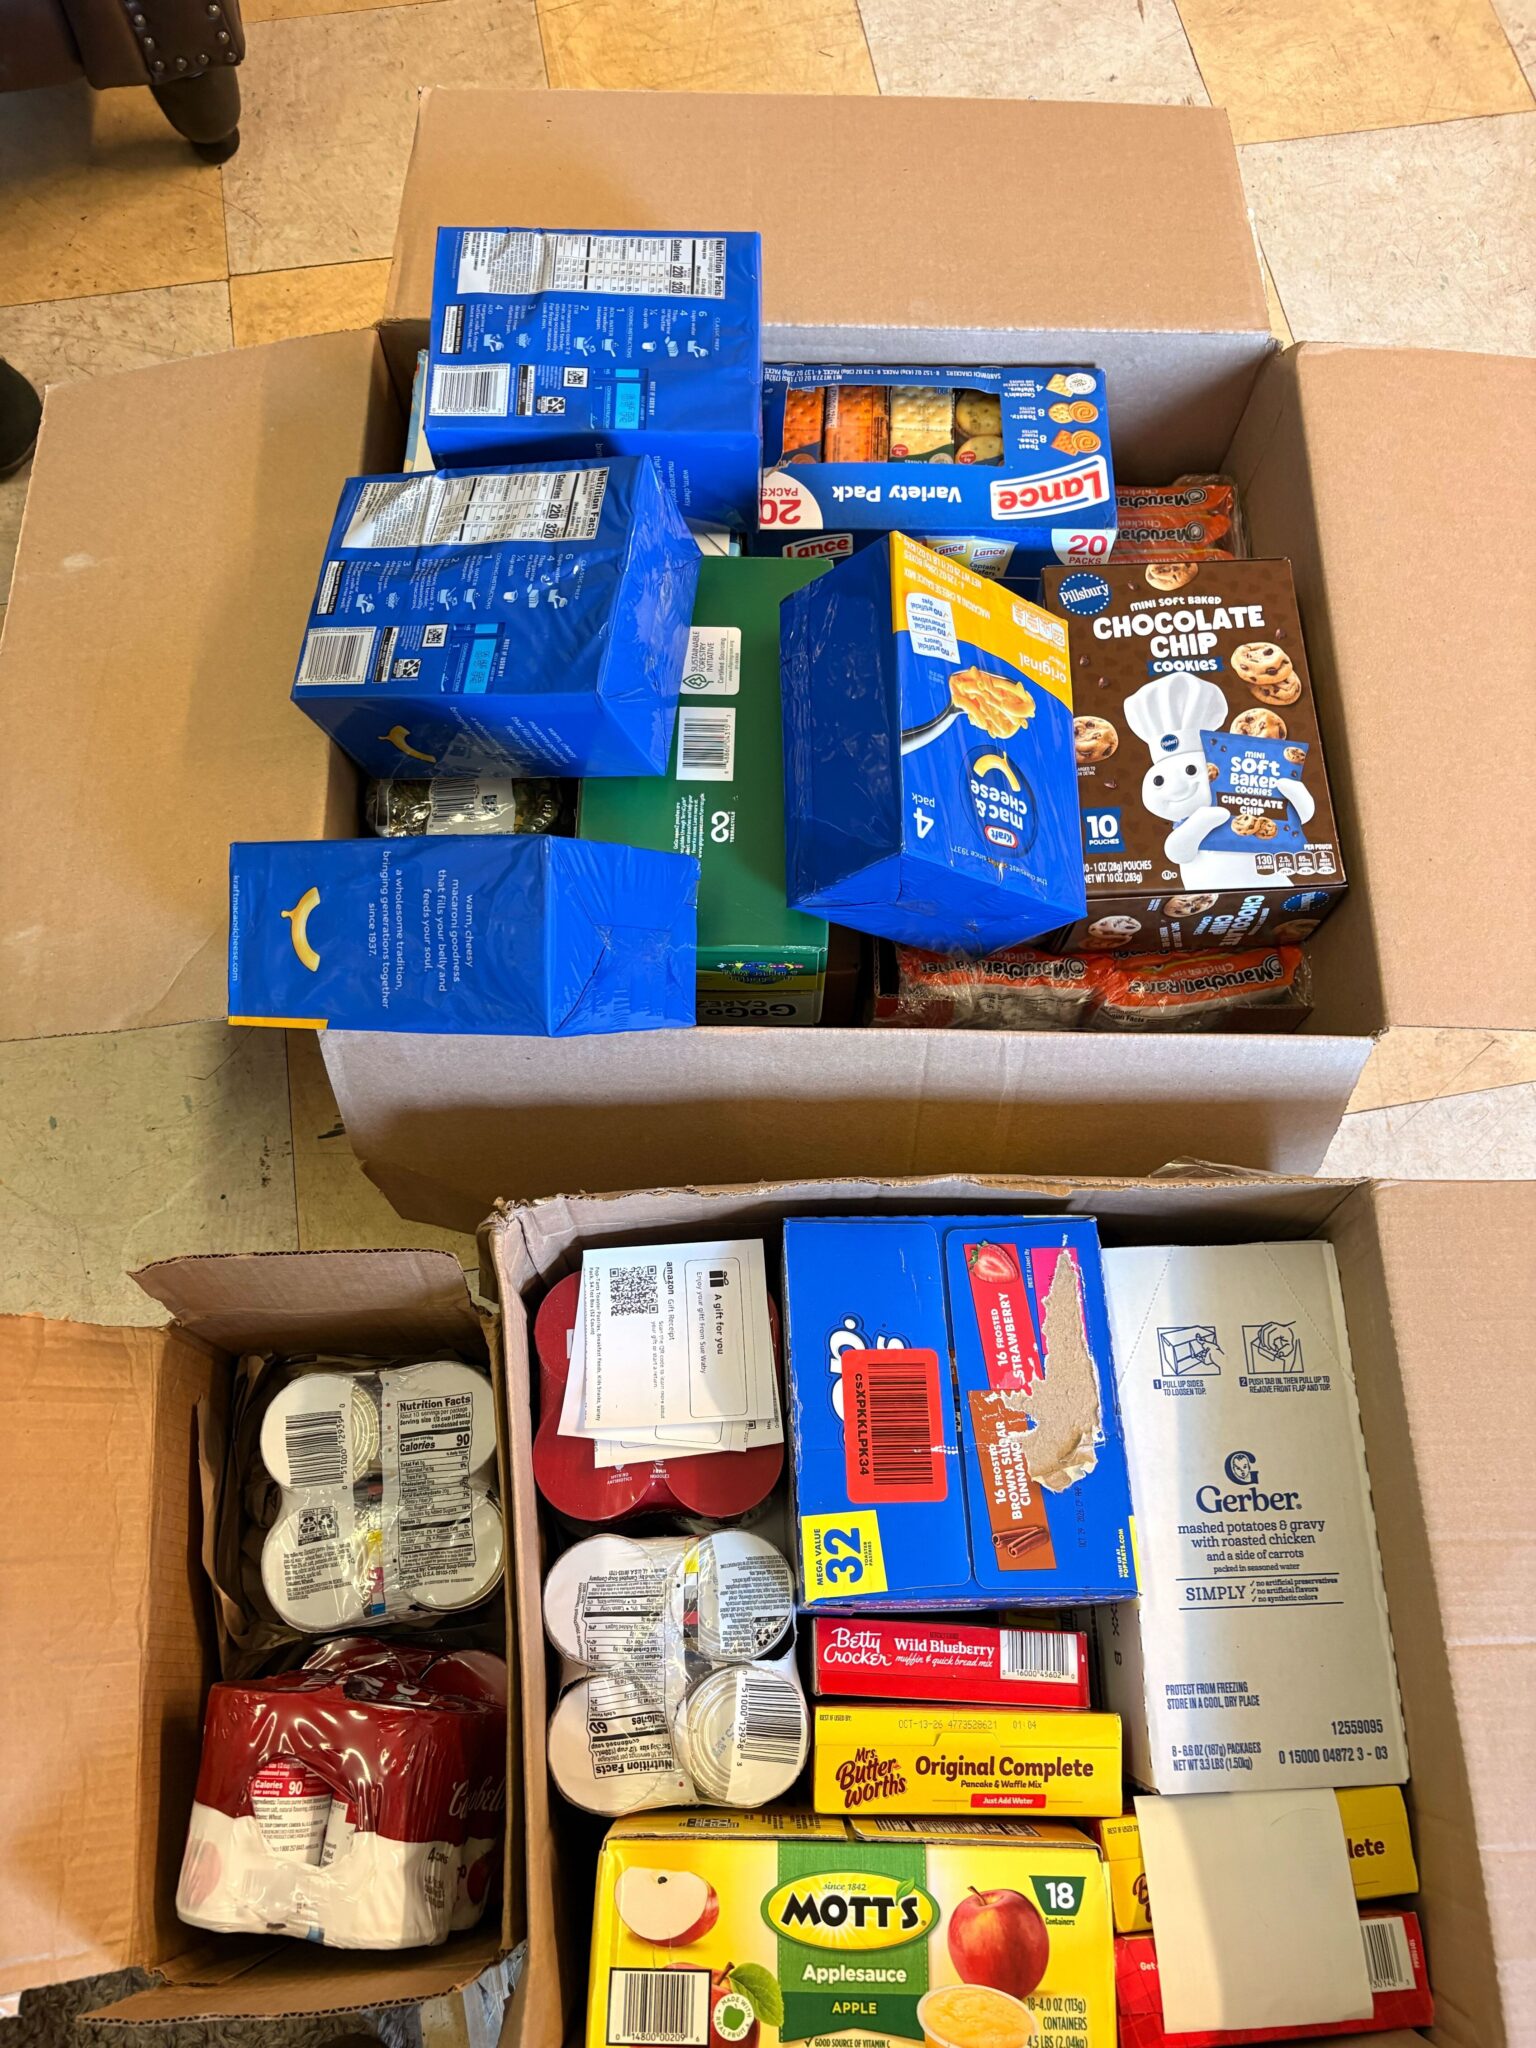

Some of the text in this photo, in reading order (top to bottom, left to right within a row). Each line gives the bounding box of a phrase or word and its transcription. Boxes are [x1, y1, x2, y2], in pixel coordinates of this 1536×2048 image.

[671, 240, 683, 294] Calories 220 320
[714, 240, 724, 297] Nutrition Facts
[761, 488, 798, 497] PACKS
[832, 485, 961, 503] Variety Pack
[997, 469, 1102, 508] Lance
[761, 499, 801, 523] 20
[974, 548, 1005, 559] Lance
[1068, 534, 1107, 556] 20
[1068, 556, 1102, 565] PACKS
[1059, 582, 1109, 605] Pillsbury
[1092, 605, 1265, 640] CHOCOLATE
[691, 631, 700, 672] SUSTAINABLE
[917, 642, 950, 656] no artificial
[924, 637, 943, 647] flavors
[1150, 632, 1218, 658] CHIP
[1018, 652, 1067, 684] original
[911, 792, 935, 808] pack
[1221, 795, 1283, 809] CHOCOLATE
[975, 798, 1023, 831] mac &
[1240, 805, 1265, 816] CHIP
[913, 807, 935, 839] 4
[1087, 814, 1118, 838] 10
[990, 827, 1013, 844] Kraft
[1089, 838, 1120, 846] POUCHES
[1108, 860, 1152, 872] (28g) POUCHES
[232, 875, 240, 982] kraftmacandcheese.com
[380, 851, 391, 1008] bringing generations together
[422, 920, 430, 944] your
[368, 932, 376, 956] 1937.
[465, 931, 473, 967] cheesy
[395, 940, 403, 990] tradition,
[424, 946, 432, 972] soul.
[438, 944, 446, 969] belly
[451, 931, 460, 982] goodness
[977, 961, 1074, 978] Maruchan
[1184, 964, 1275, 994] Maruchan
[439, 971, 447, 992] and
[696, 1289, 704, 1305] your
[714, 1303, 723, 1319] gift
[715, 1321, 723, 1335] for
[990, 1308, 1007, 1366] 16 FROSTED
[998, 1293, 1024, 1379] STRAWBERRY
[715, 1337, 724, 1355] you
[400, 1396, 471, 1411] Nutrition Facts
[400, 1433, 470, 1452] Calories 90
[989, 1443, 1006, 1504] 16 FROSTED
[1006, 1472, 1023, 1520] BROWN
[1196, 1485, 1298, 1513] Gerber
[1177, 1518, 1325, 1536] mashed potatoes & gravy
[1192, 1533, 1316, 1548] with roasted chicken
[813, 1528, 824, 1586] MEGA VALUE
[823, 1527, 863, 1584] 32
[1207, 1549, 1304, 1561] and a side of carrots
[1186, 1585, 1246, 1601] SIMPLY
[831, 1628, 882, 1649] Betty
[894, 1638, 995, 1656] Wild Blueberry
[823, 1643, 892, 1666] Crocker
[895, 1655, 993, 1668] muffin quick bread mix
[1016, 1670, 1062, 1679] 16000 45602
[1166, 1682, 1248, 1695] PROTECT FROM FREEZING
[631, 1715, 666, 1725] Calories
[898, 1719, 944, 1729] OCT-13-26
[1331, 1719, 1383, 1736] 12559095
[855, 1747, 878, 1762] Mrs.
[1290, 1748, 1354, 1764] 15000 04872
[596, 1760, 672, 1774] Nutrition Facts
[915, 1756, 1094, 1782] Original Complete
[844, 1773, 906, 1808] worth's
[961, 1780, 1042, 1789] Pancake & Waffle Mix
[823, 1881, 867, 1892] since 1842
[1045, 1882, 1075, 1909] 18
[780, 1892, 919, 1930] MOTT'S
[802, 1963, 907, 1983] Applesauce
[832, 2002, 877, 2014] APPLE
[1064, 1998, 1086, 2013] (113g)
[1043, 2017, 1087, 2031] CONTAINERS
